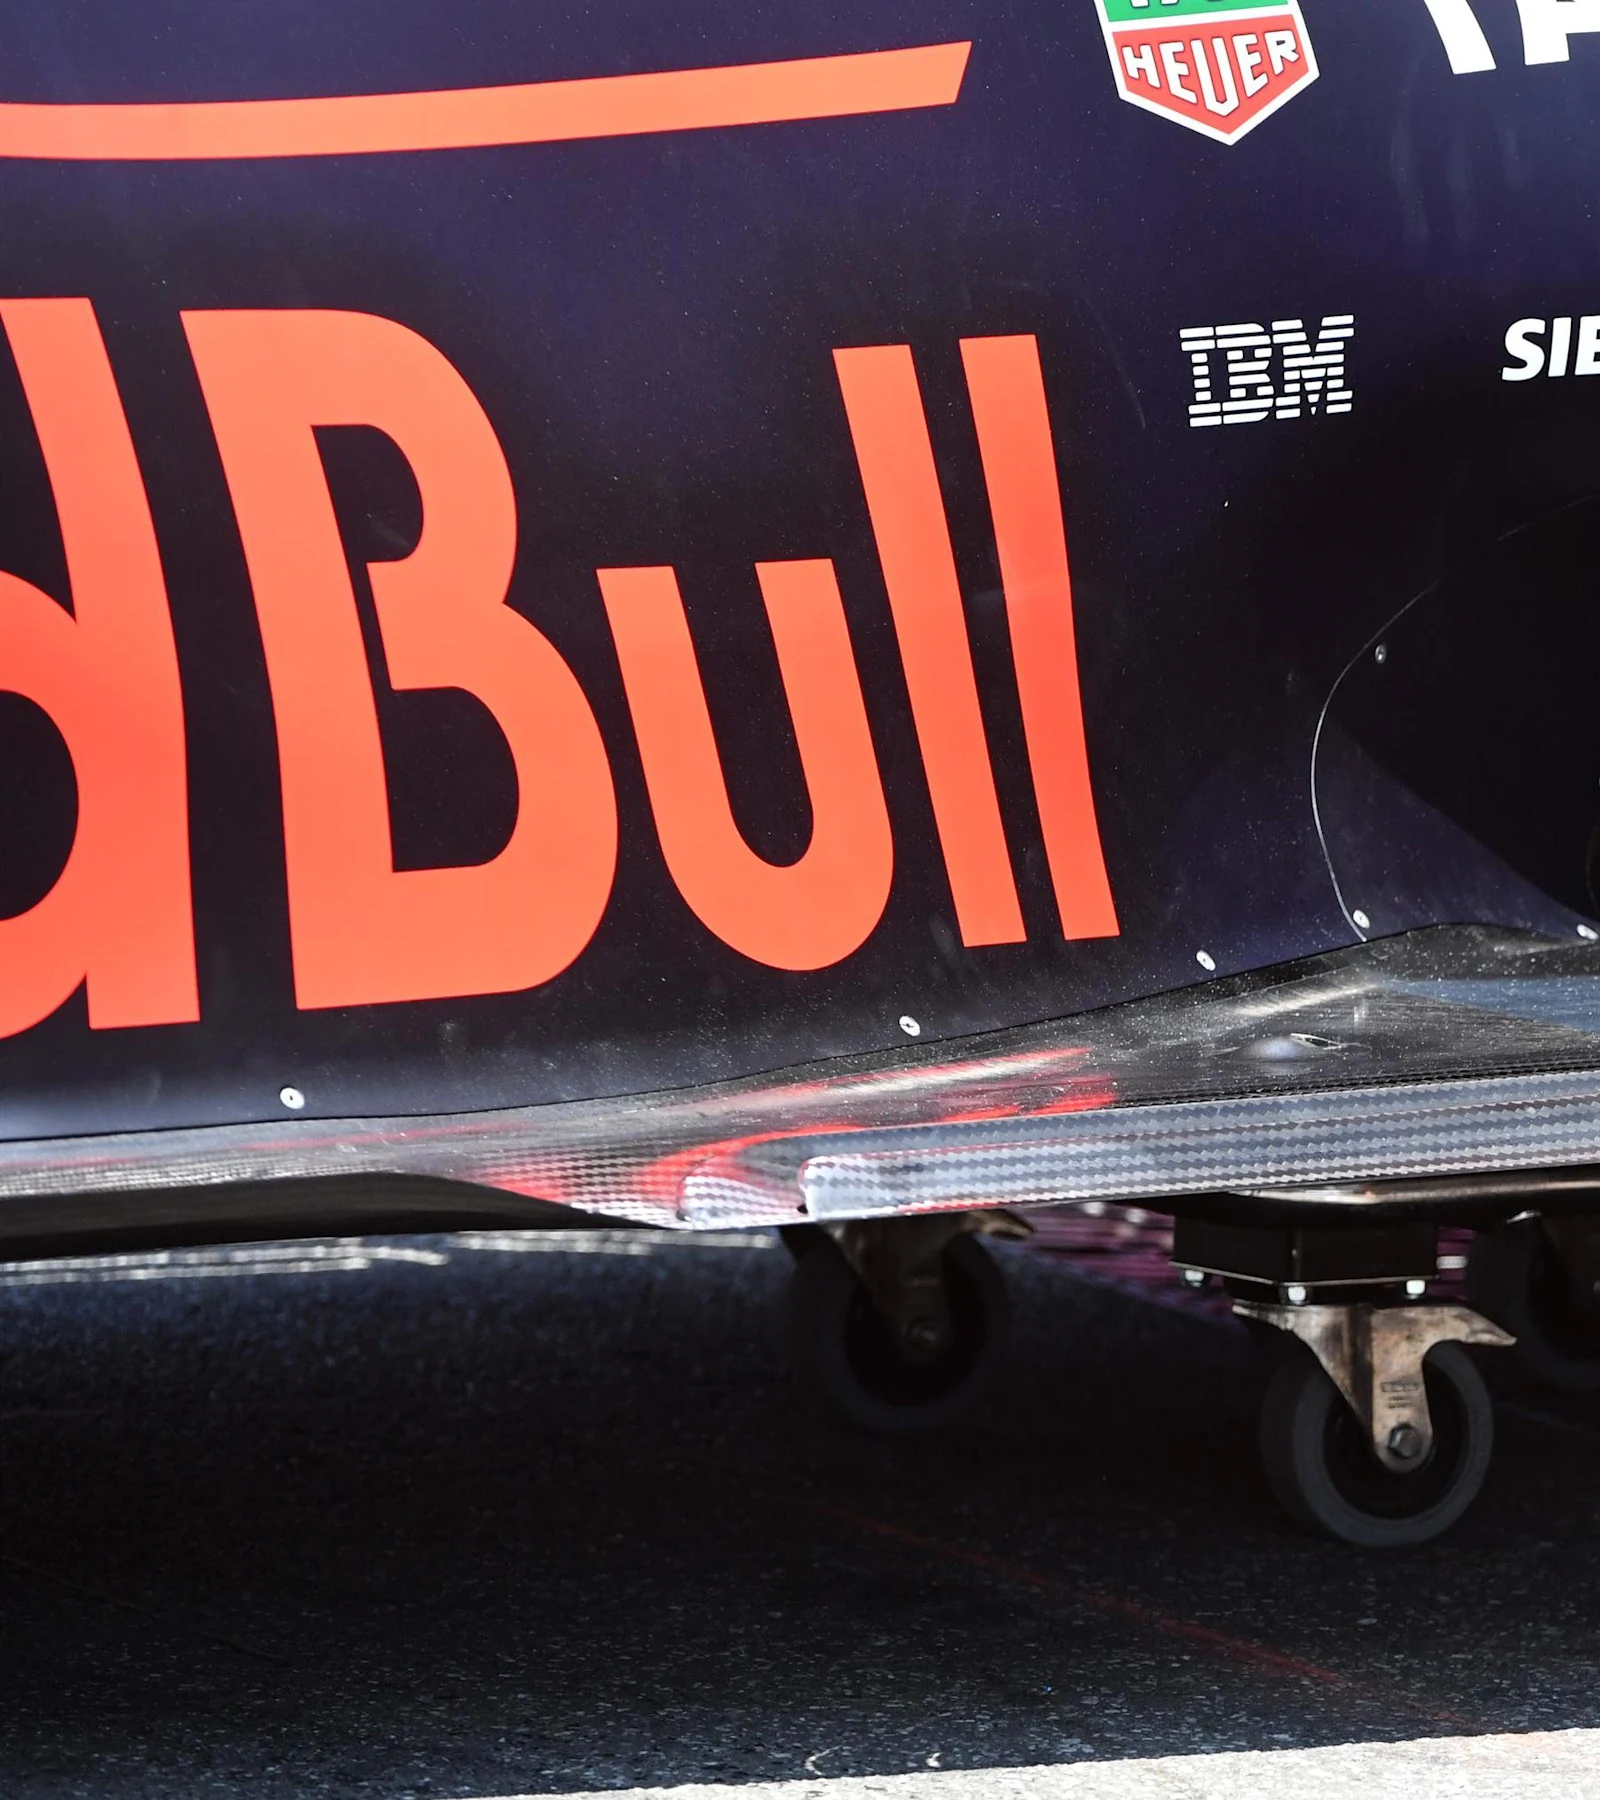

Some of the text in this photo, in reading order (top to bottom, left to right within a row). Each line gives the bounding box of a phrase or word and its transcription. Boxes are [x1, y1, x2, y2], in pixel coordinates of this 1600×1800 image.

[1121, 29, 1301, 117] HEUER
[1179, 314, 1355, 427] IBM
[179, 308, 1120, 1011] Bull
